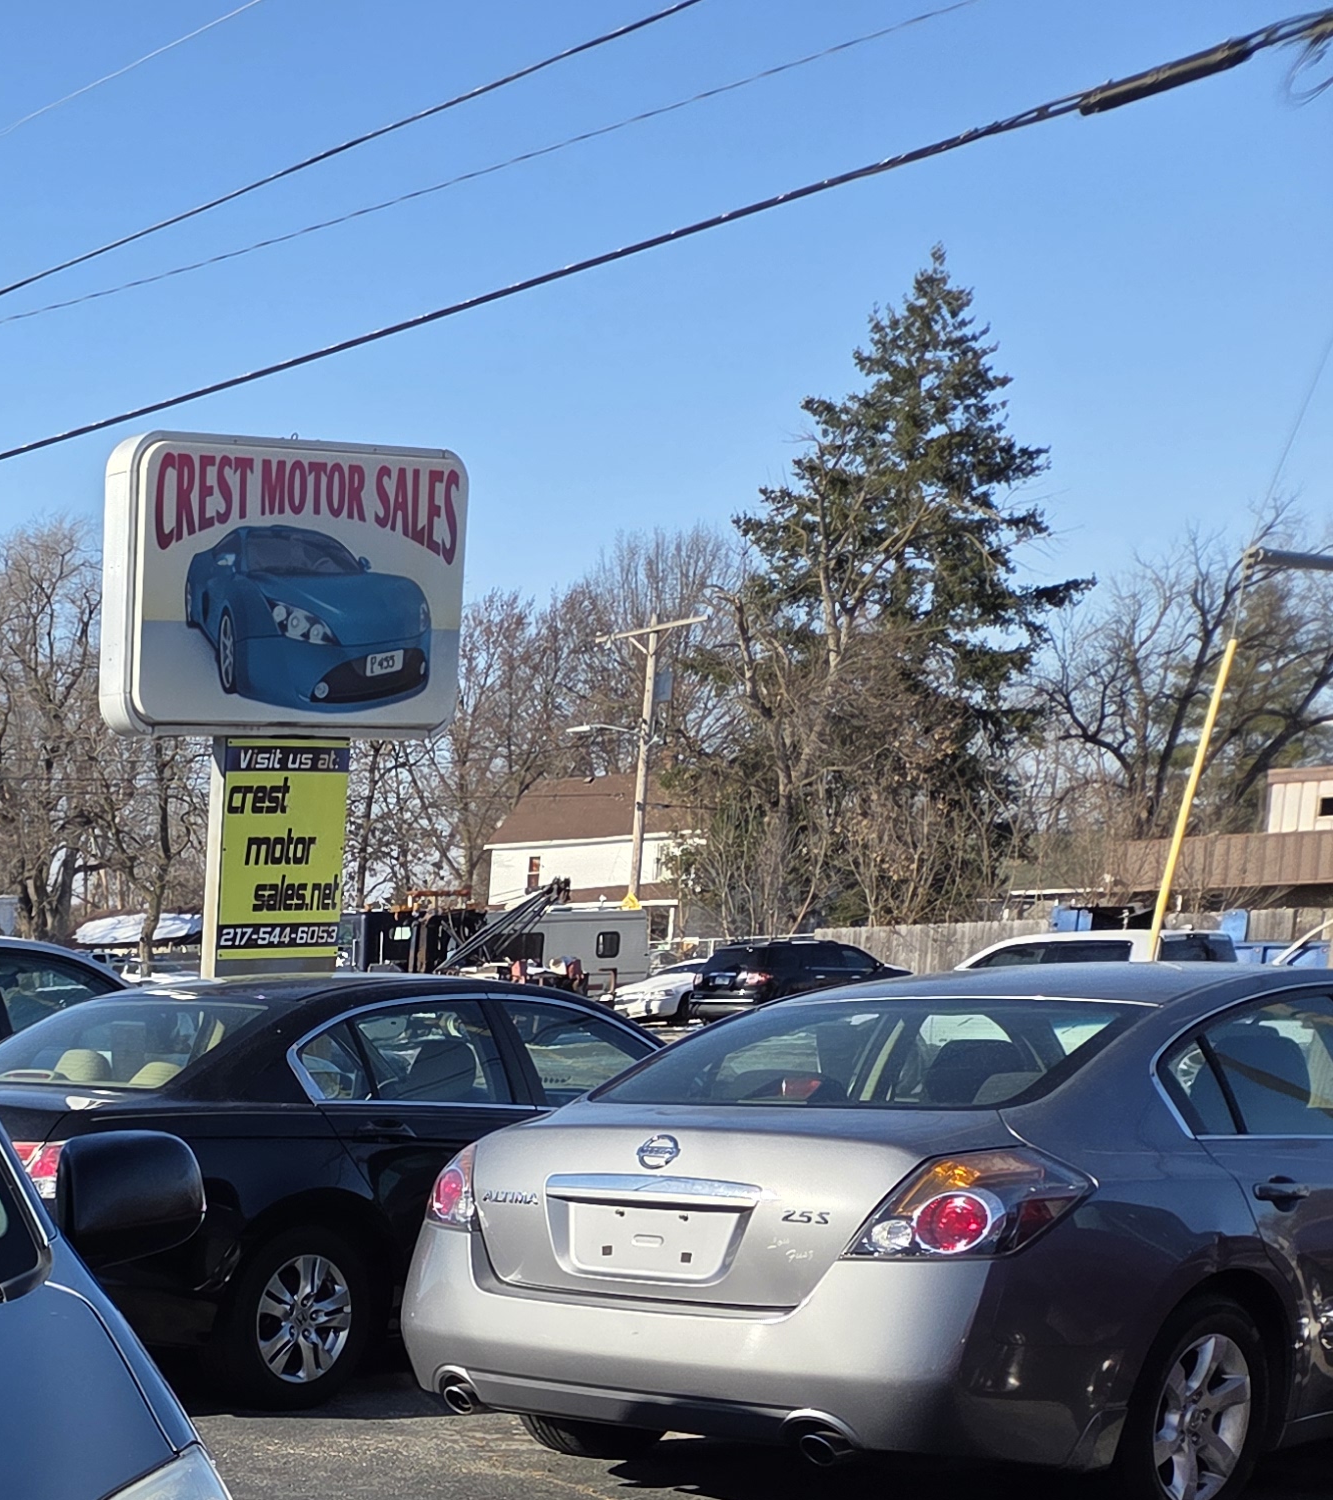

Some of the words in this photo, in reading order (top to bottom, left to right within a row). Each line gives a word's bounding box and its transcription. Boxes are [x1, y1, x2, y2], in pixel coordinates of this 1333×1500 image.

[154, 452, 255, 550] CREST
[260, 458, 366, 523] MOTOR
[374, 464, 460, 565] SALES
[240, 749, 282, 770] Visit
[287, 753, 313, 770] us
[317, 752, 340, 770] at:
[227, 776, 290, 814] crest
[244, 828, 317, 866] motor
[252, 874, 340, 912] sales.net
[220, 926, 338, 946] 217-544-6053
[483, 1190, 539, 1206] ALTIMA
